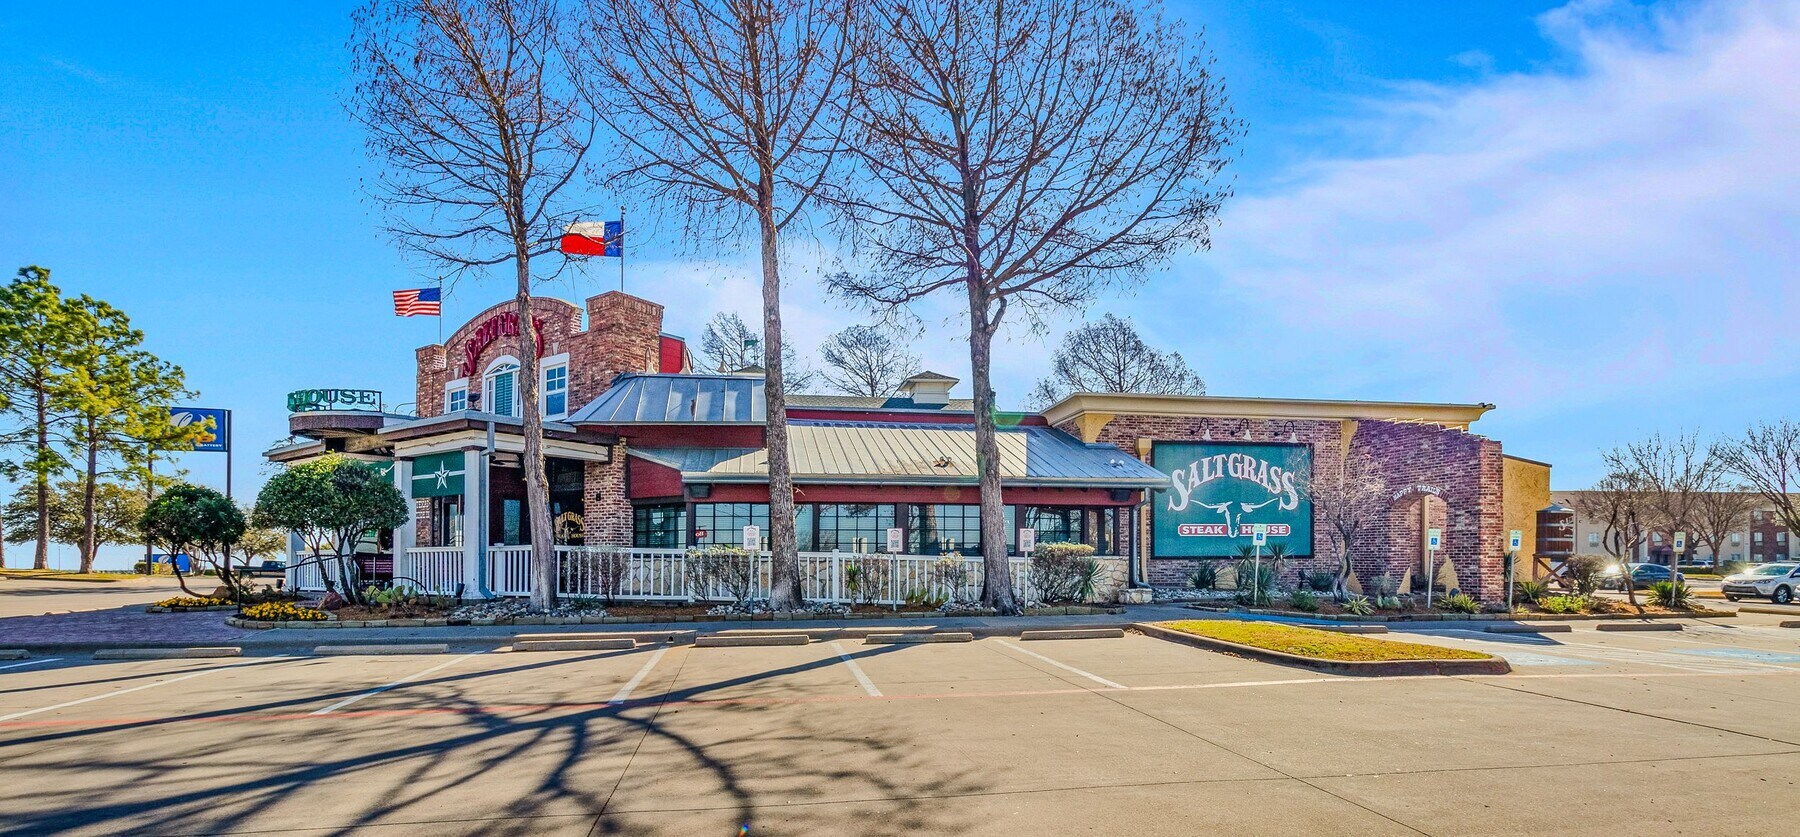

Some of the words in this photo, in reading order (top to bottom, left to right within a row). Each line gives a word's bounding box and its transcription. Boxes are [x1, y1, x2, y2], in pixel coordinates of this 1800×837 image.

[1168, 453, 1298, 511] SALTGRASS
[1392, 486, 1412, 501] HAPPY
[1417, 485, 1441, 495] TRAILS
[1182, 525, 1223, 534] STEAK
[1242, 525, 1286, 534] HUSE
